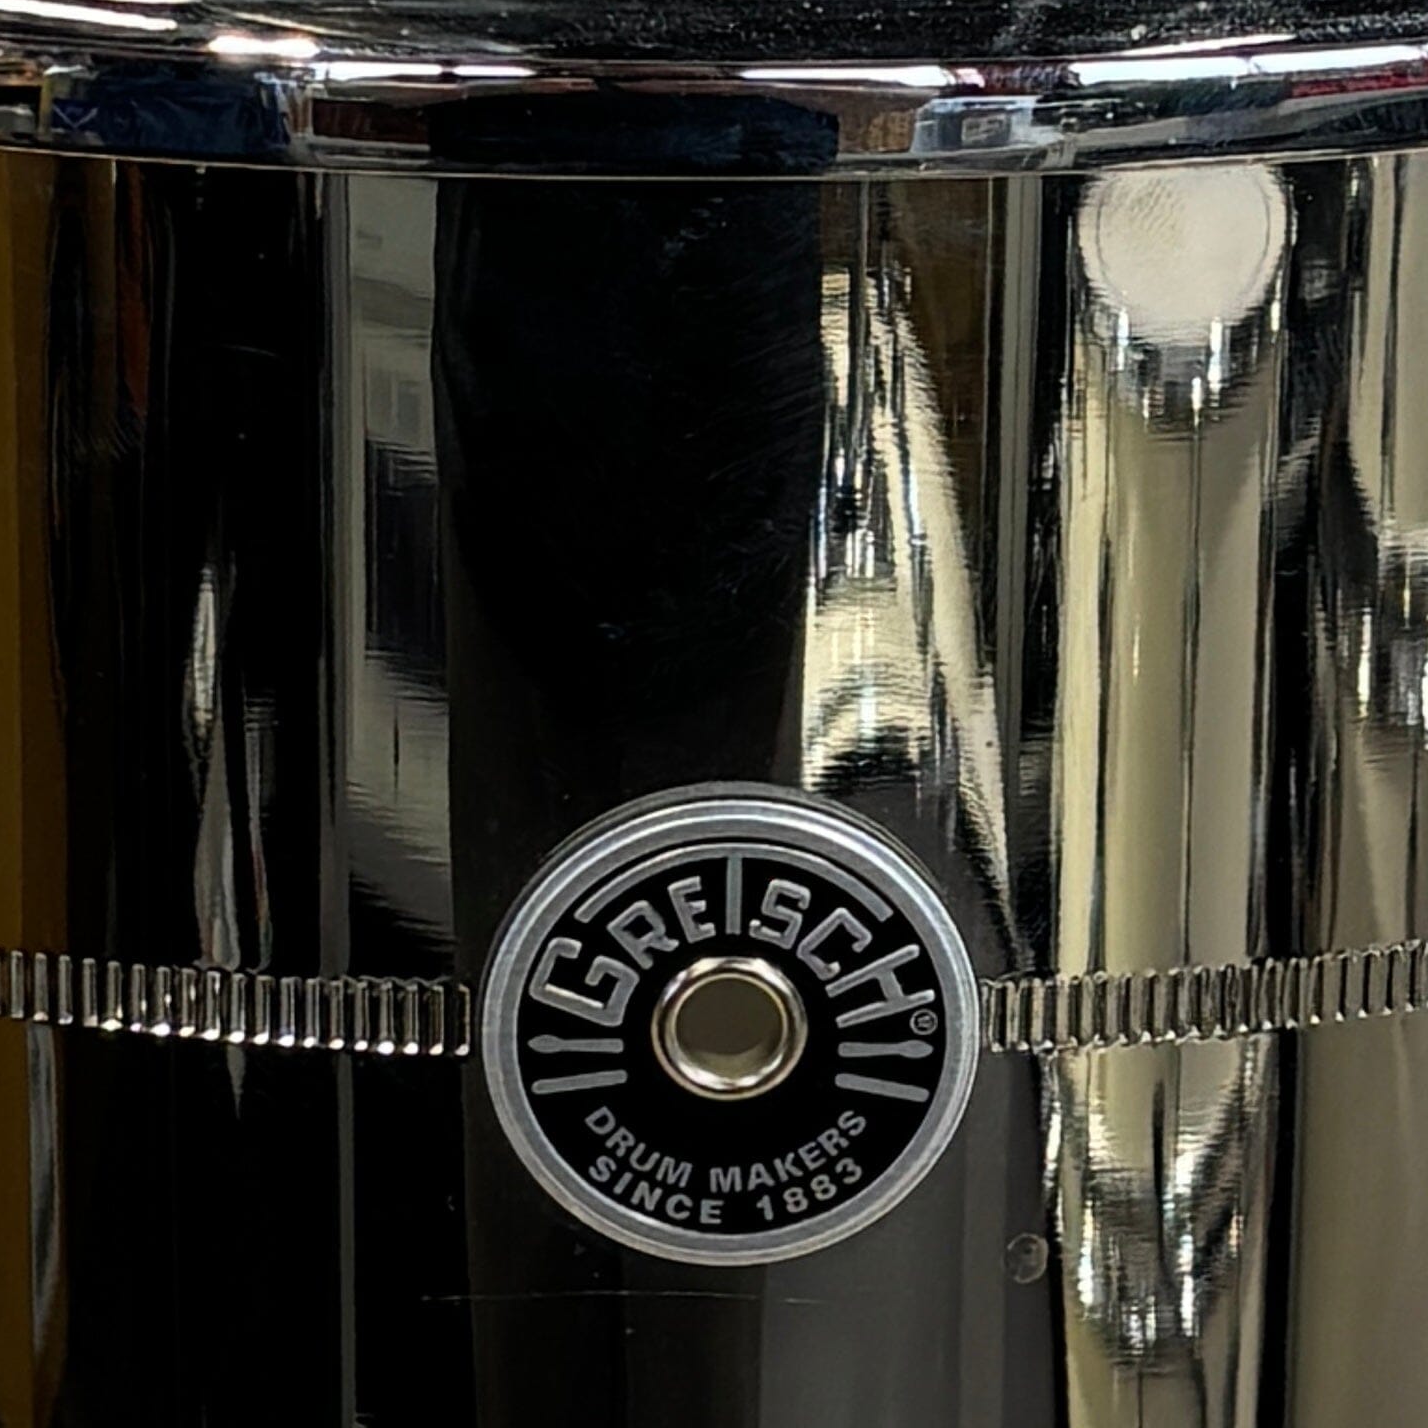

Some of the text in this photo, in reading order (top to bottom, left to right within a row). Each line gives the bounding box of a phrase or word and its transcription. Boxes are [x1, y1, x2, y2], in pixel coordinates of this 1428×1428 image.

[529, 842, 935, 1028] GRETSCH
[584, 1105, 867, 1193] DRUM MAKERS
[588, 1155, 863, 1224] SINCE 1883
